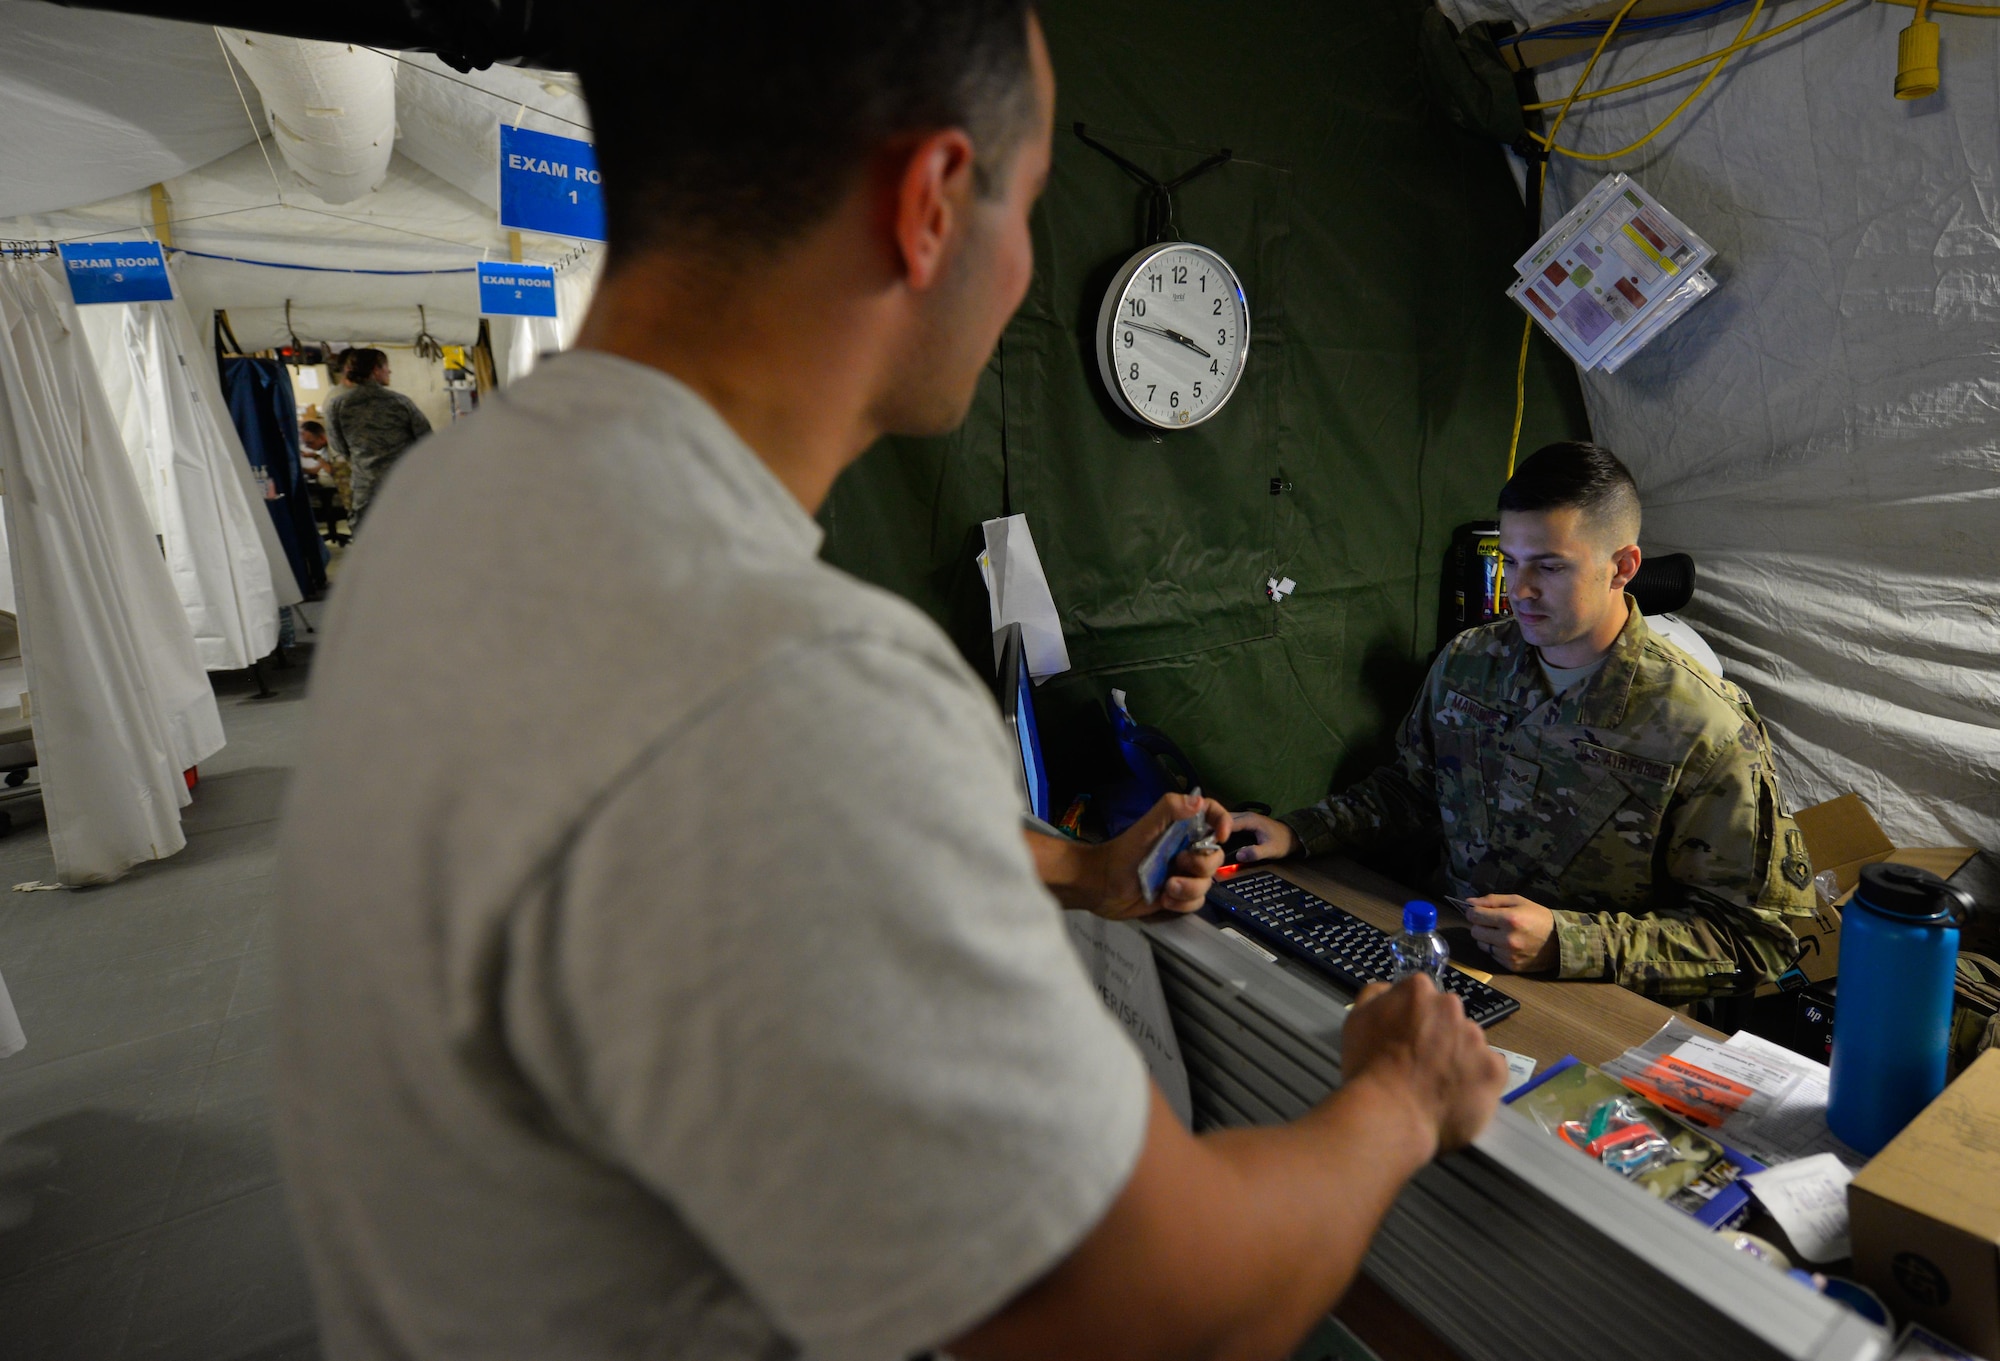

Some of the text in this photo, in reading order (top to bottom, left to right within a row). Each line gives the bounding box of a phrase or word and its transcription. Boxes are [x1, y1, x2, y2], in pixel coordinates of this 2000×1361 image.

[508, 153, 568, 178] EXAM
[568, 190, 578, 204] 1
[68, 257, 160, 269] EXAM ROOM
[114, 273, 123, 282] 3
[482, 275, 551, 288] EXAM ROOM
[1149, 274, 1162, 292] 11
[1171, 266, 1188, 284] 12
[1200, 275, 1206, 293] 1
[514, 290, 522, 299] 2
[1129, 299, 1146, 317] 10
[1213, 299, 1222, 315] 2
[1124, 331, 1134, 348] 9
[1217, 329, 1226, 345] 3
[1129, 363, 1139, 380] 8
[1209, 359, 1218, 375] 4
[1147, 385, 1157, 402] 7
[1193, 382, 1202, 398] 5
[1170, 391, 1179, 408] 6
[1603, 753, 1627, 770] AIR
[1629, 758, 1669, 780] FORCE
[1806, 1006, 1822, 1022] hp
[1668, 1063, 1732, 1090] BIOHAZARD
